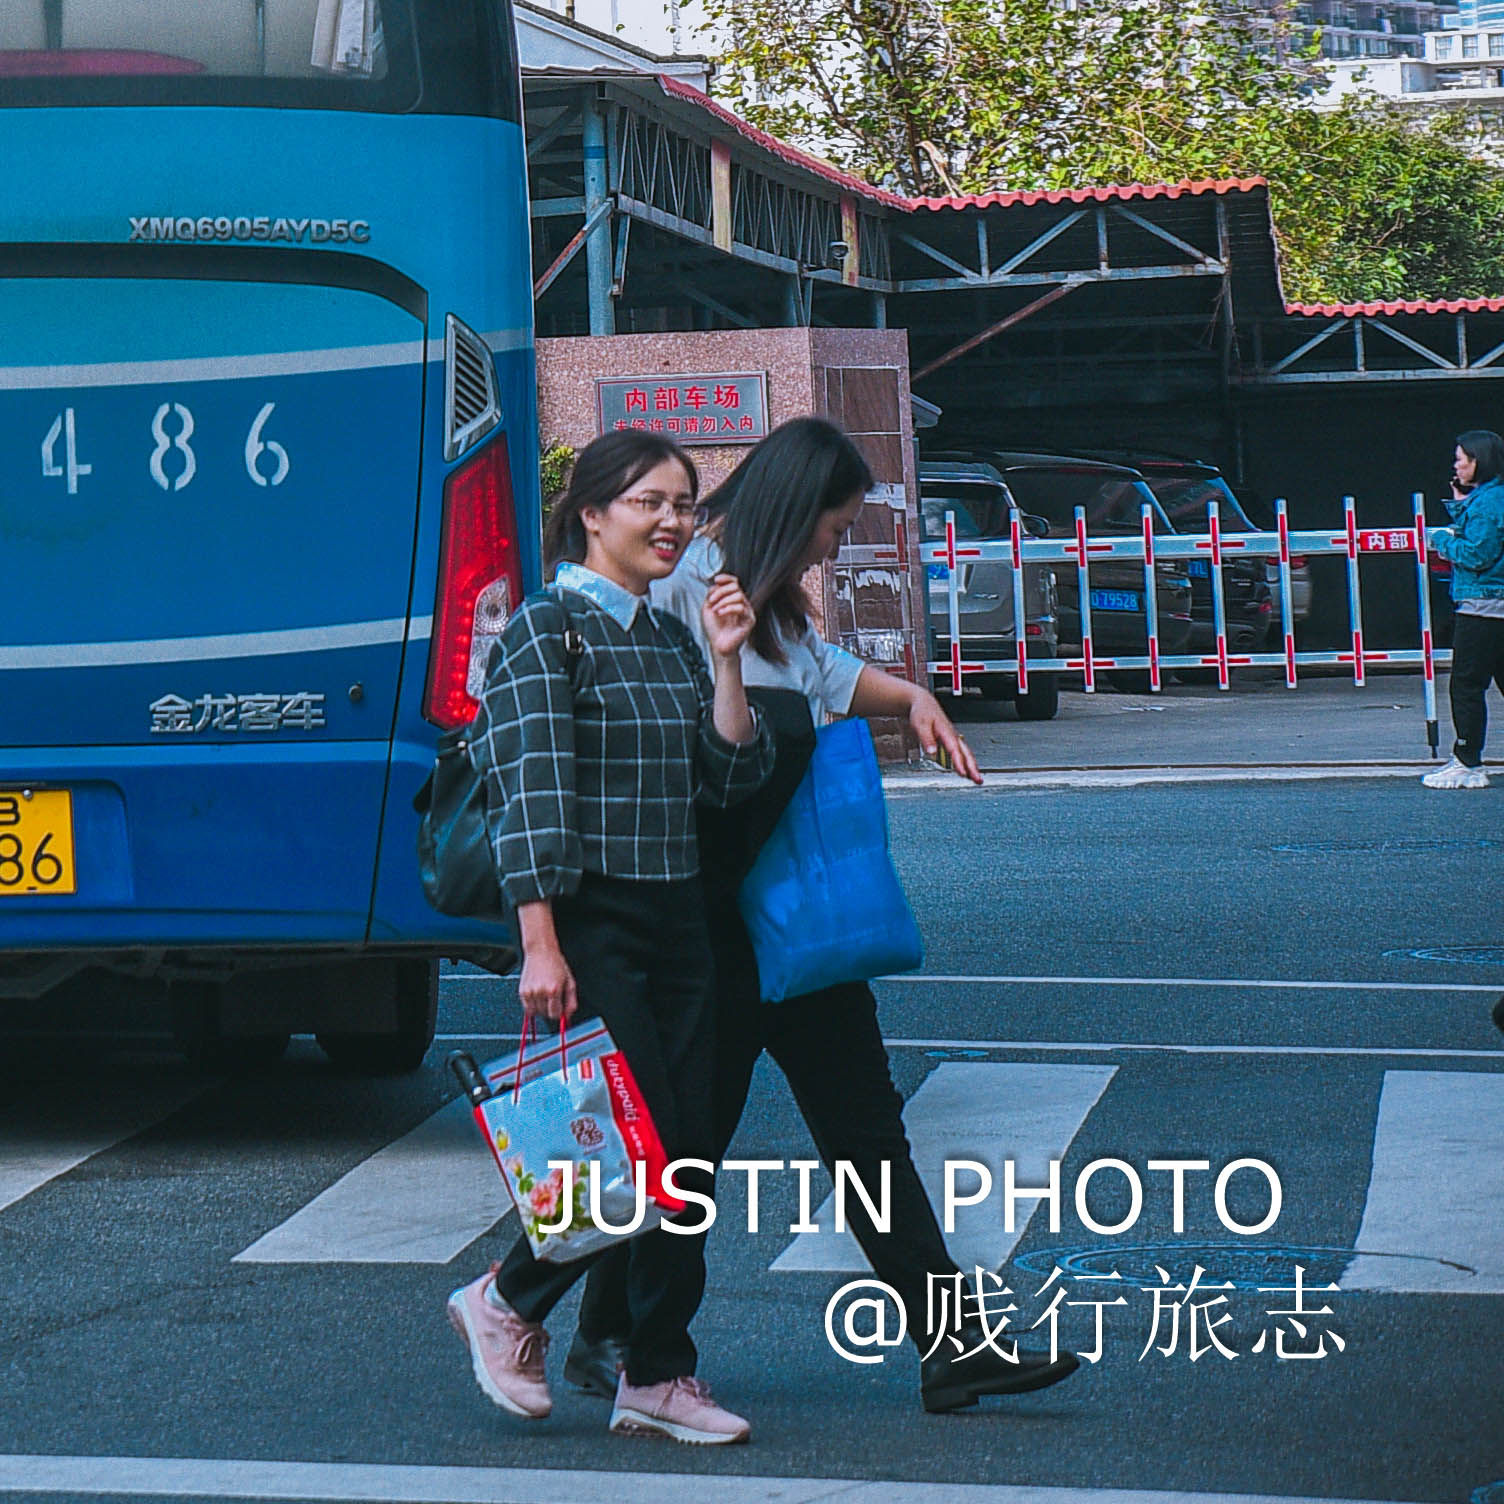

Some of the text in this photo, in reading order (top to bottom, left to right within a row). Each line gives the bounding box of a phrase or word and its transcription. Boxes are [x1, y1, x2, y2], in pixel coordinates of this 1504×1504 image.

[128, 216, 370, 243] XMQ6905AYD5C
[624, 384, 741, 414] 内部车场
[612, 415, 754, 435] 未经许可请勿入内
[1367, 533, 1409, 550] 内部
[149, 692, 326, 734] 金龙客车
